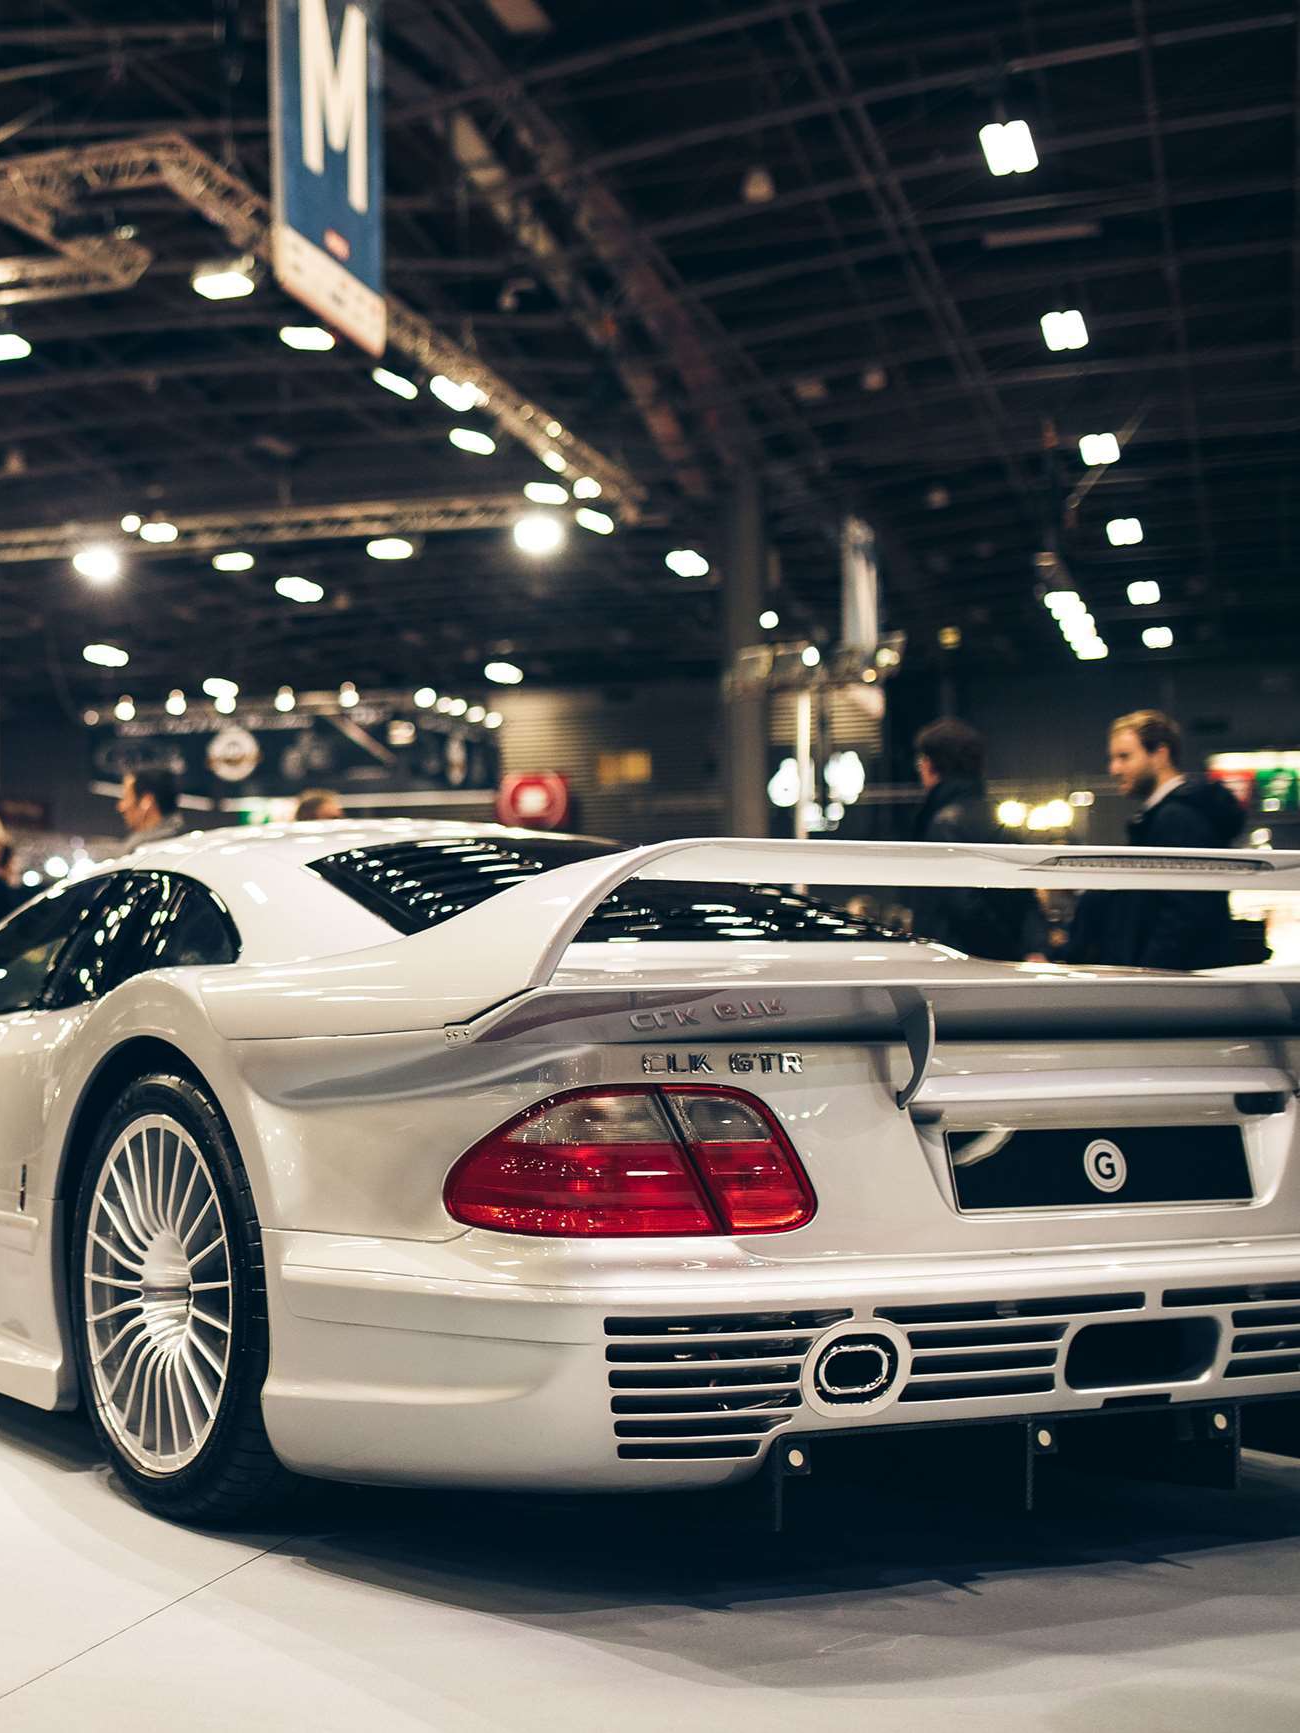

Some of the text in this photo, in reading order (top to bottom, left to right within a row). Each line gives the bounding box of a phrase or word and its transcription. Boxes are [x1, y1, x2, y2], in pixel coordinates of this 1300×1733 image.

[299, 0, 368, 214] M
[642, 1052, 803, 1075] CLK GTR
[1094, 1151, 1117, 1180] G
